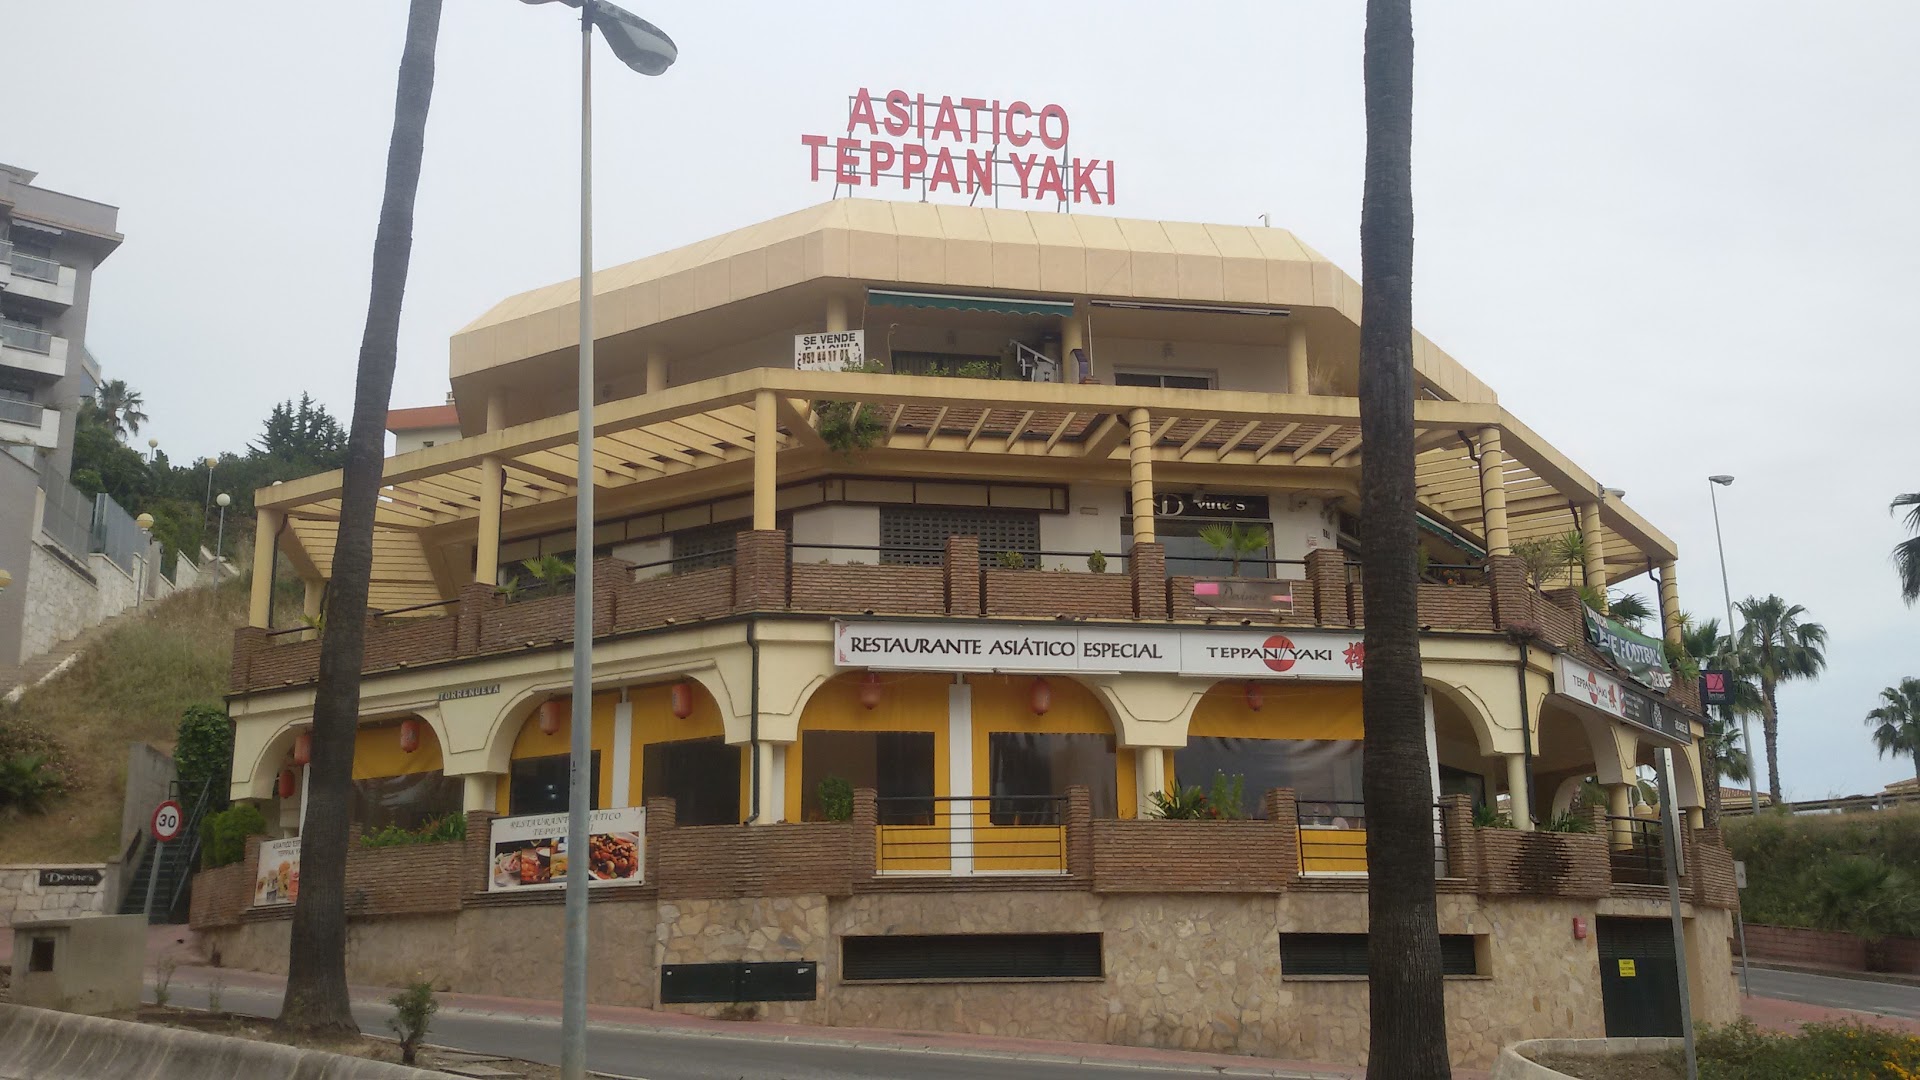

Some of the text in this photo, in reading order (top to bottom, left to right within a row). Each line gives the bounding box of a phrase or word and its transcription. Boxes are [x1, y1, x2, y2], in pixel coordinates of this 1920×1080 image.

[847, 88, 1069, 150] ASIATICO
[802, 134, 1115, 205] TEPPAN YAKI
[803, 333, 855, 345] SE VENDE
[850, 636, 1163, 659] RESTAURANTE ASIÁTICO ESPECIAL
[1206, 647, 1332, 660] TEPPAN YAKI
[439, 684, 500, 700] TORRENUEVA
[159, 814, 176, 828] 30
[510, 816, 569, 828] RESTAURANT
